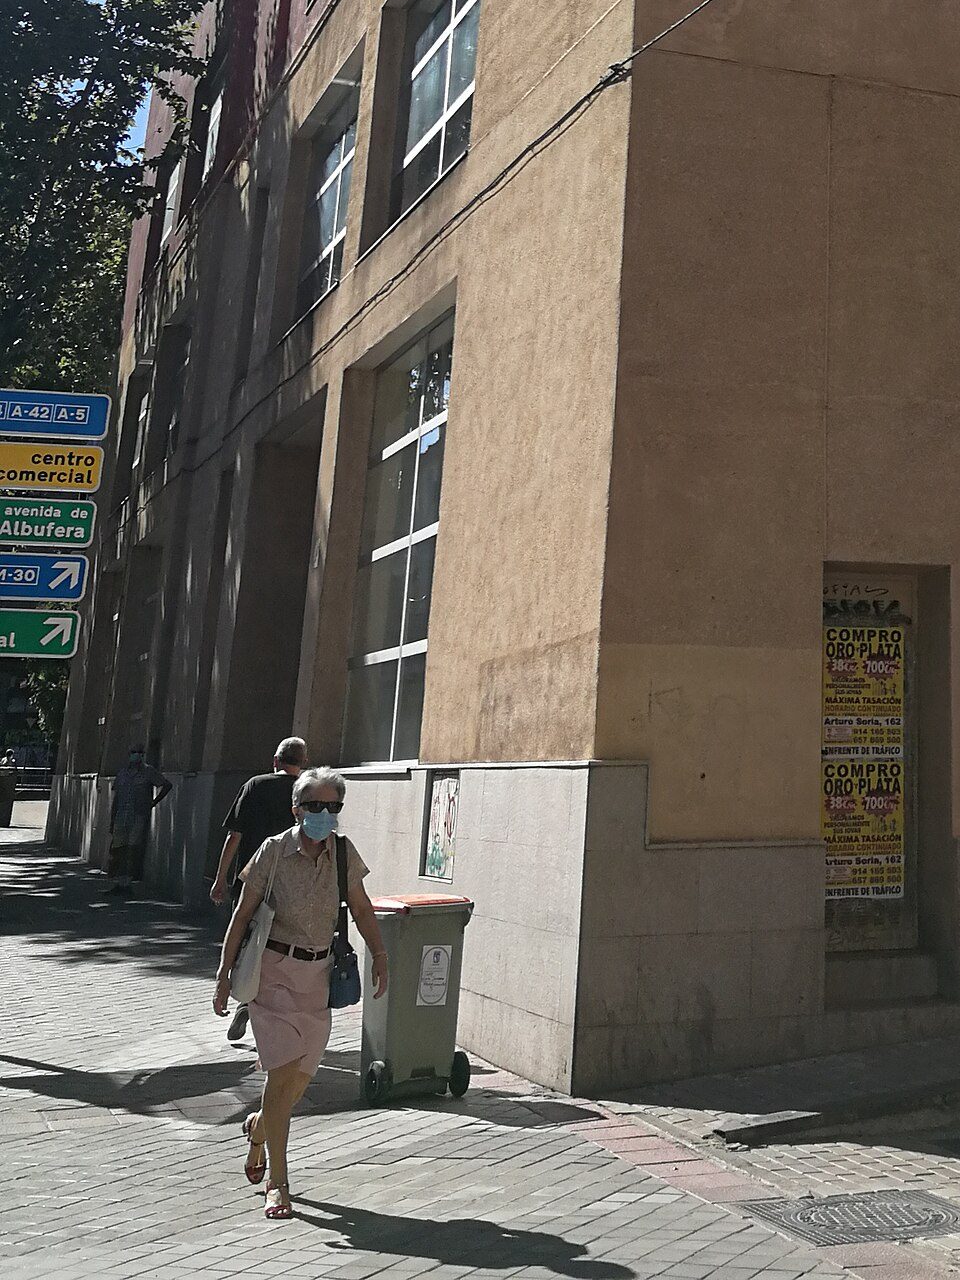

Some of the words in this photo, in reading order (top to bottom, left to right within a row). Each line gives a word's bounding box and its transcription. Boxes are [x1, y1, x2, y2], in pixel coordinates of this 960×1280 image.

[11, 405, 50, 419] A-42
[57, 407, 86, 421] A-5
[31, 451, 96, 467] centro
[4, 505, 62, 518] avenida
[70, 507, 89, 519] de
[0, 519, 85, 539] Albufera
[826, 628, 902, 643] COMPRO
[825, 642, 855, 659] ORO
[860, 642, 902, 659] PLATA
[825, 696, 861, 704] MÁXIMA
[861, 696, 901, 705] TASACIÓN
[857, 704, 901, 713] CONTINUADO
[824, 717, 854, 726] Arturo
[856, 717, 882, 727] Soria,
[884, 717, 902, 726] 162
[824, 746, 859, 756] ENFRENTE
[861, 746, 870, 755] DE
[872, 744, 901, 755] TRÁFICO
[824, 763, 901, 778] COMPRO
[823, 778, 854, 796] ORO
[858, 777, 901, 795] PLATA
[860, 834, 902, 843] TASACIÓN
[856, 843, 901, 851] CONTINUADO
[855, 857, 882, 866] Soria,
[885, 855, 902, 864] 162
[860, 886, 870, 896] DE
[871, 884, 901, 895] TRÁFICO
